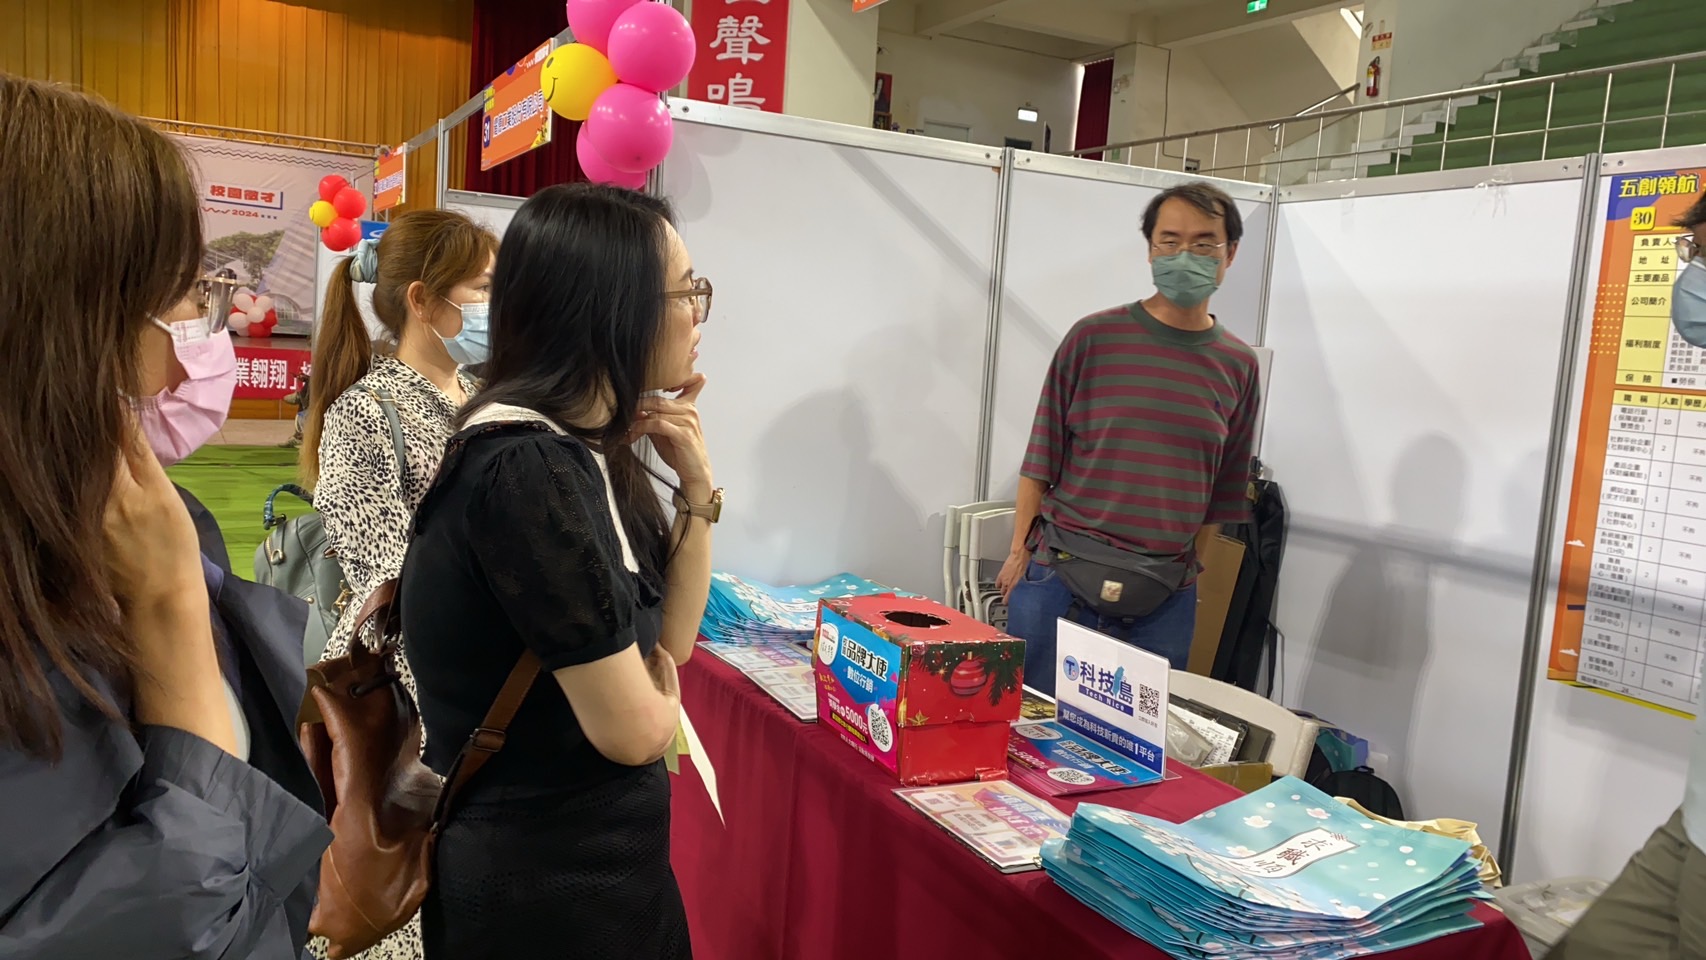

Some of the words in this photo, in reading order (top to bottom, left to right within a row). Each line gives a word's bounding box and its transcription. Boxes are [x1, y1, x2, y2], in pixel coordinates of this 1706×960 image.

[709, 0, 771, 110] 聲鳴
[210, 185, 275, 203] 校園徵才
[1618, 174, 1698, 197] 五創領航
[232, 209, 259, 218] 2024
[1633, 212, 1652, 225] 30
[1634, 274, 1669, 282] 主要產品
[1631, 297, 1667, 306] 公司簡介
[1625, 339, 1662, 348] 福利制度
[847, 638, 889, 681] 品牌大使
[1080, 661, 1134, 704] 科技島
[1085, 688, 1104, 703] Tech
[1107, 696, 1125, 711] Nice
